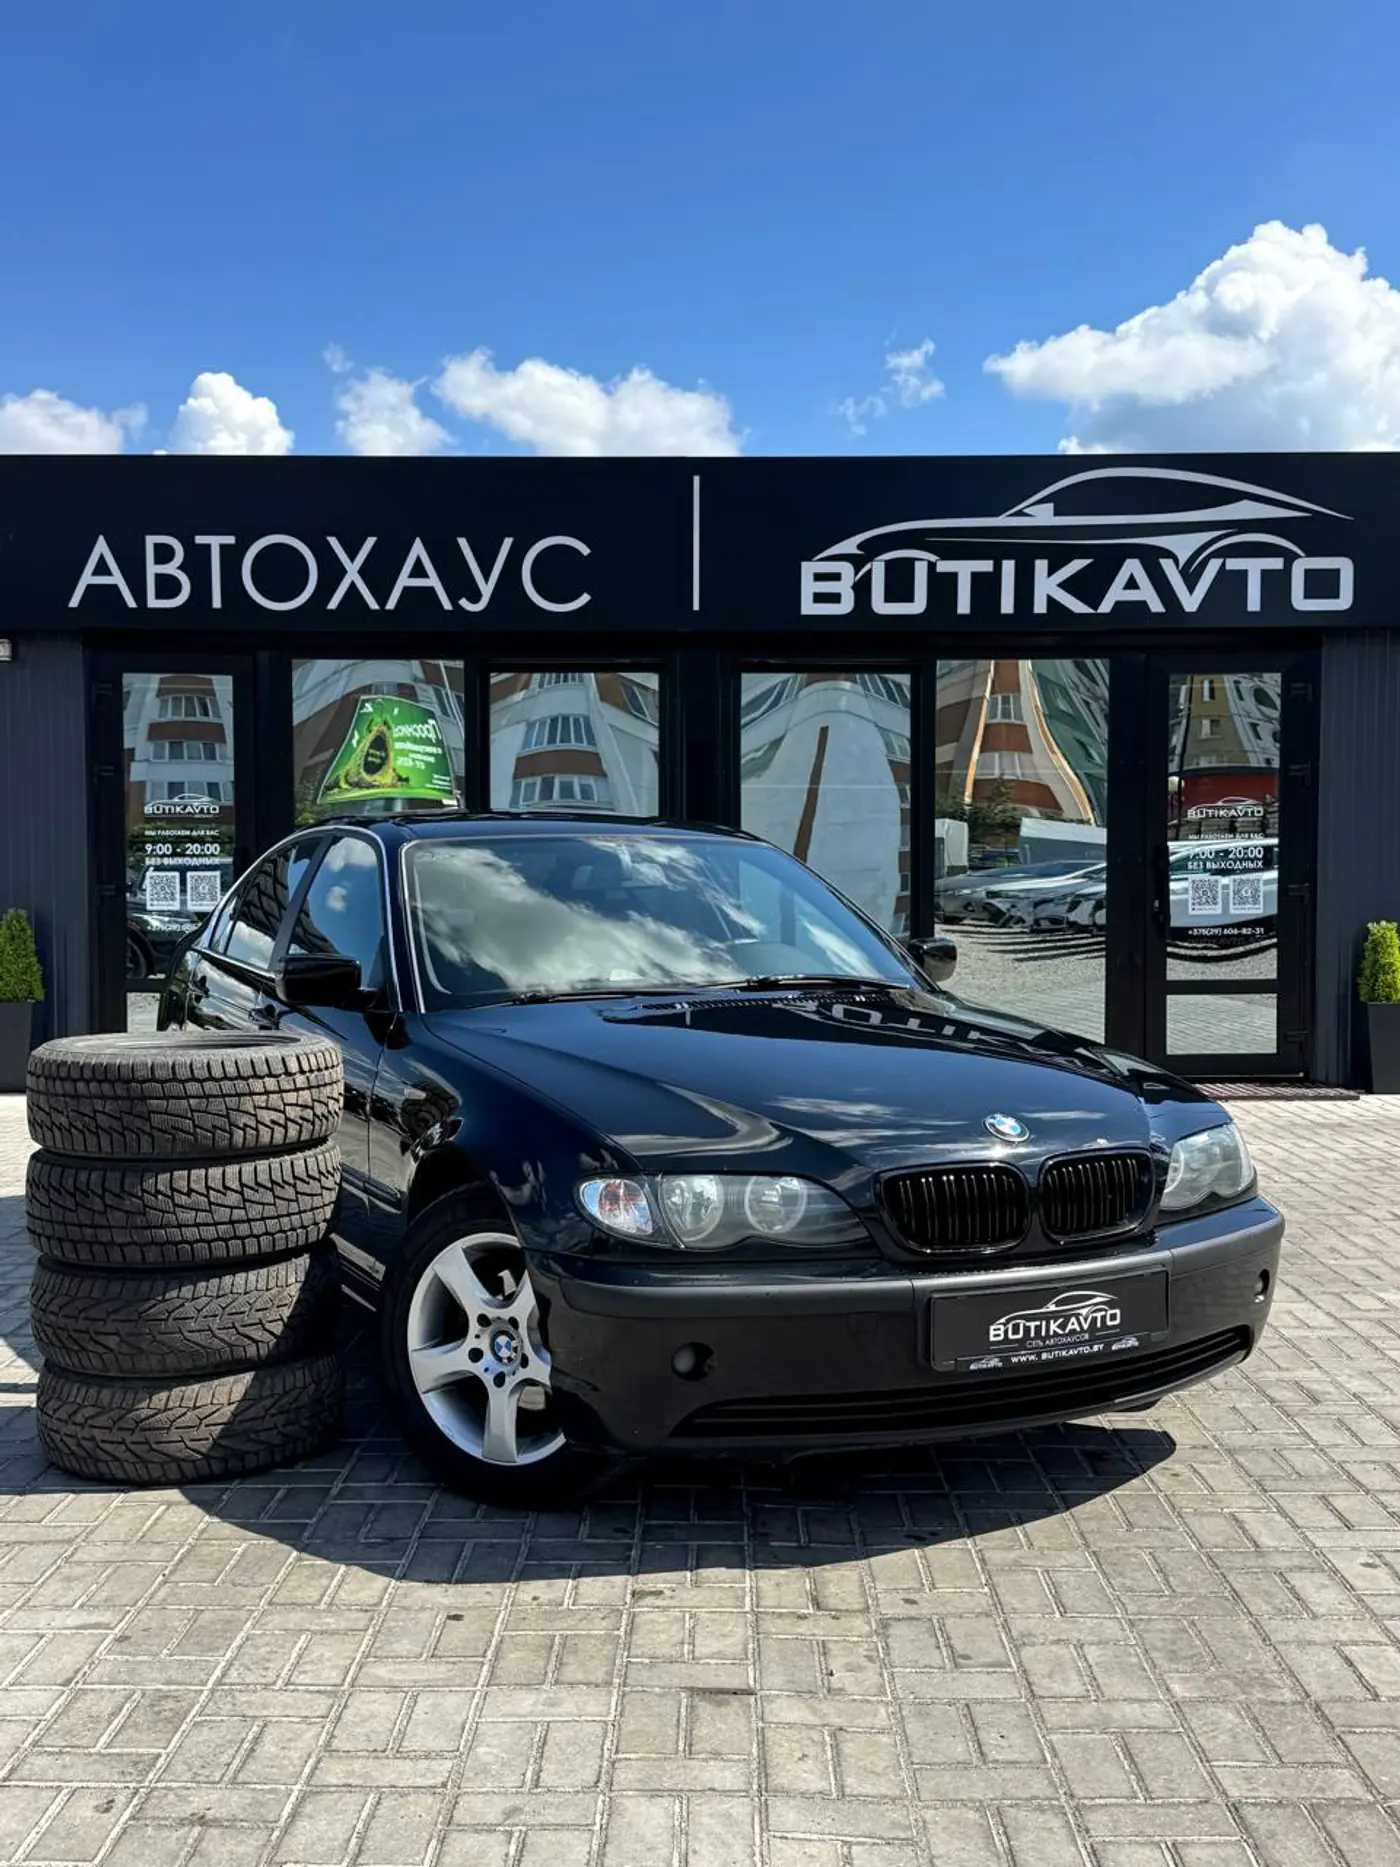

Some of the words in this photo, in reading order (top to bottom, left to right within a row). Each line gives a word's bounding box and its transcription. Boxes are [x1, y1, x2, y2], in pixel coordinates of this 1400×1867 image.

[68, 534, 592, 613] АВТОХАУС
[800, 556, 1355, 616] BUTIKAVTO
[144, 804, 220, 814] BUTIKAVTO
[1187, 807, 1264, 818] BUTIKAVTO
[145, 843, 172, 855] 9:00
[185, 843, 220, 855] 20:00
[1228, 847, 1264, 859] 20:00
[1187, 861, 1204, 869] БЕЗ
[1206, 860, 1264, 870] ВЫХОДНЫХ
[989, 1308, 1121, 1342] BUTIKAVTO
